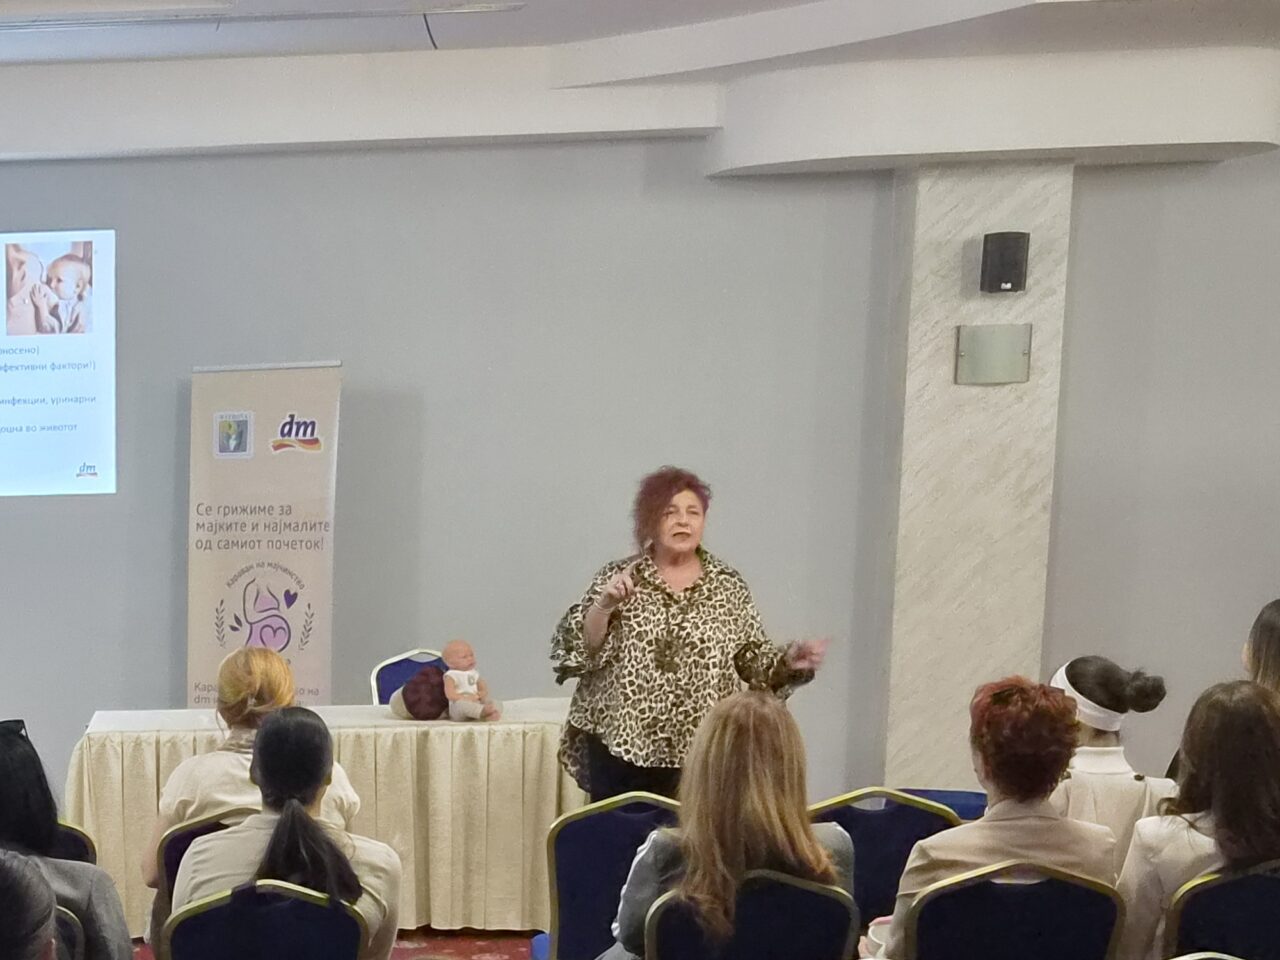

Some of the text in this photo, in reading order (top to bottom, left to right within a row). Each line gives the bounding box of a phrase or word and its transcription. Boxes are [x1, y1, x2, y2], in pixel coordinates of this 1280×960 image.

[25, 425, 37, 433] во
[279, 413, 317, 438] dm
[79, 461, 97, 473] dm
[196, 503, 293, 518] Се грижиме за
[195, 519, 331, 535] мајките и најмалите
[194, 536, 324, 552] од самиот почеток!
[193, 696, 210, 704] dm
